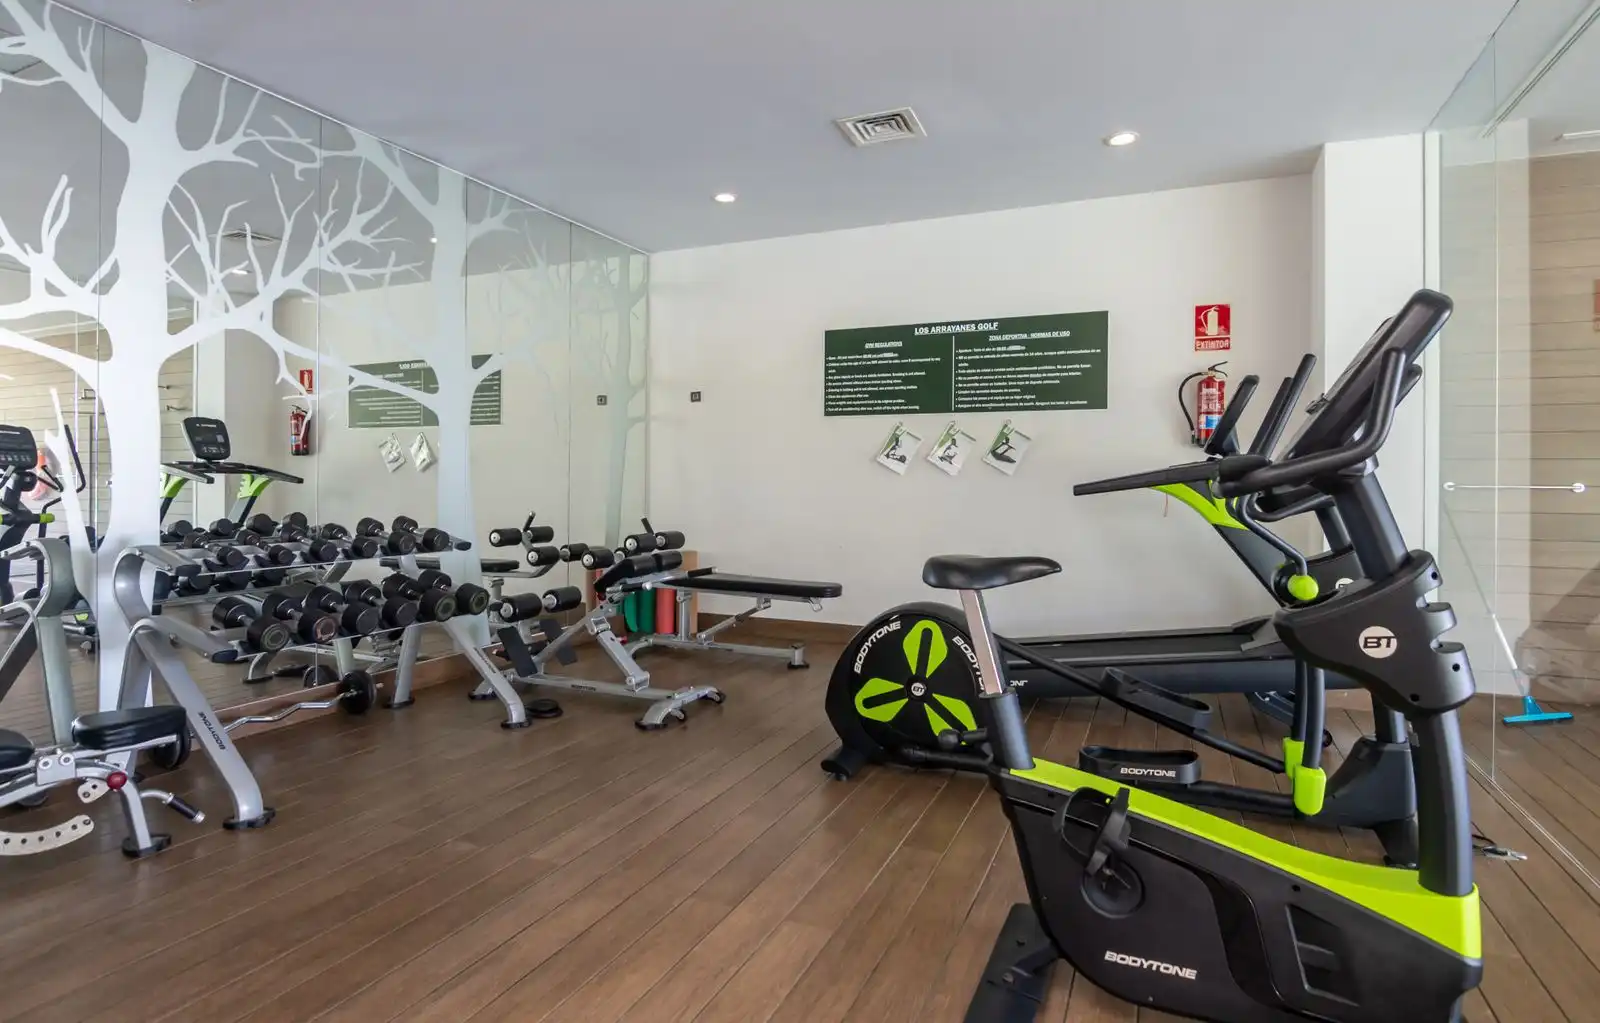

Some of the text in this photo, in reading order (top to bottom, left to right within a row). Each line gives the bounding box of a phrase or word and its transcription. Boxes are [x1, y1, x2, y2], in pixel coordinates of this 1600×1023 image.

[914, 321, 999, 335] LOS ARRAYANES GOLF
[1196, 339, 1229, 350] EXTINTOR
[854, 620, 901, 674] BODYTONE
[1363, 635, 1397, 649] BT
[1120, 767, 1177, 778] BODYTONE
[1104, 949, 1198, 980] BODYTONE
